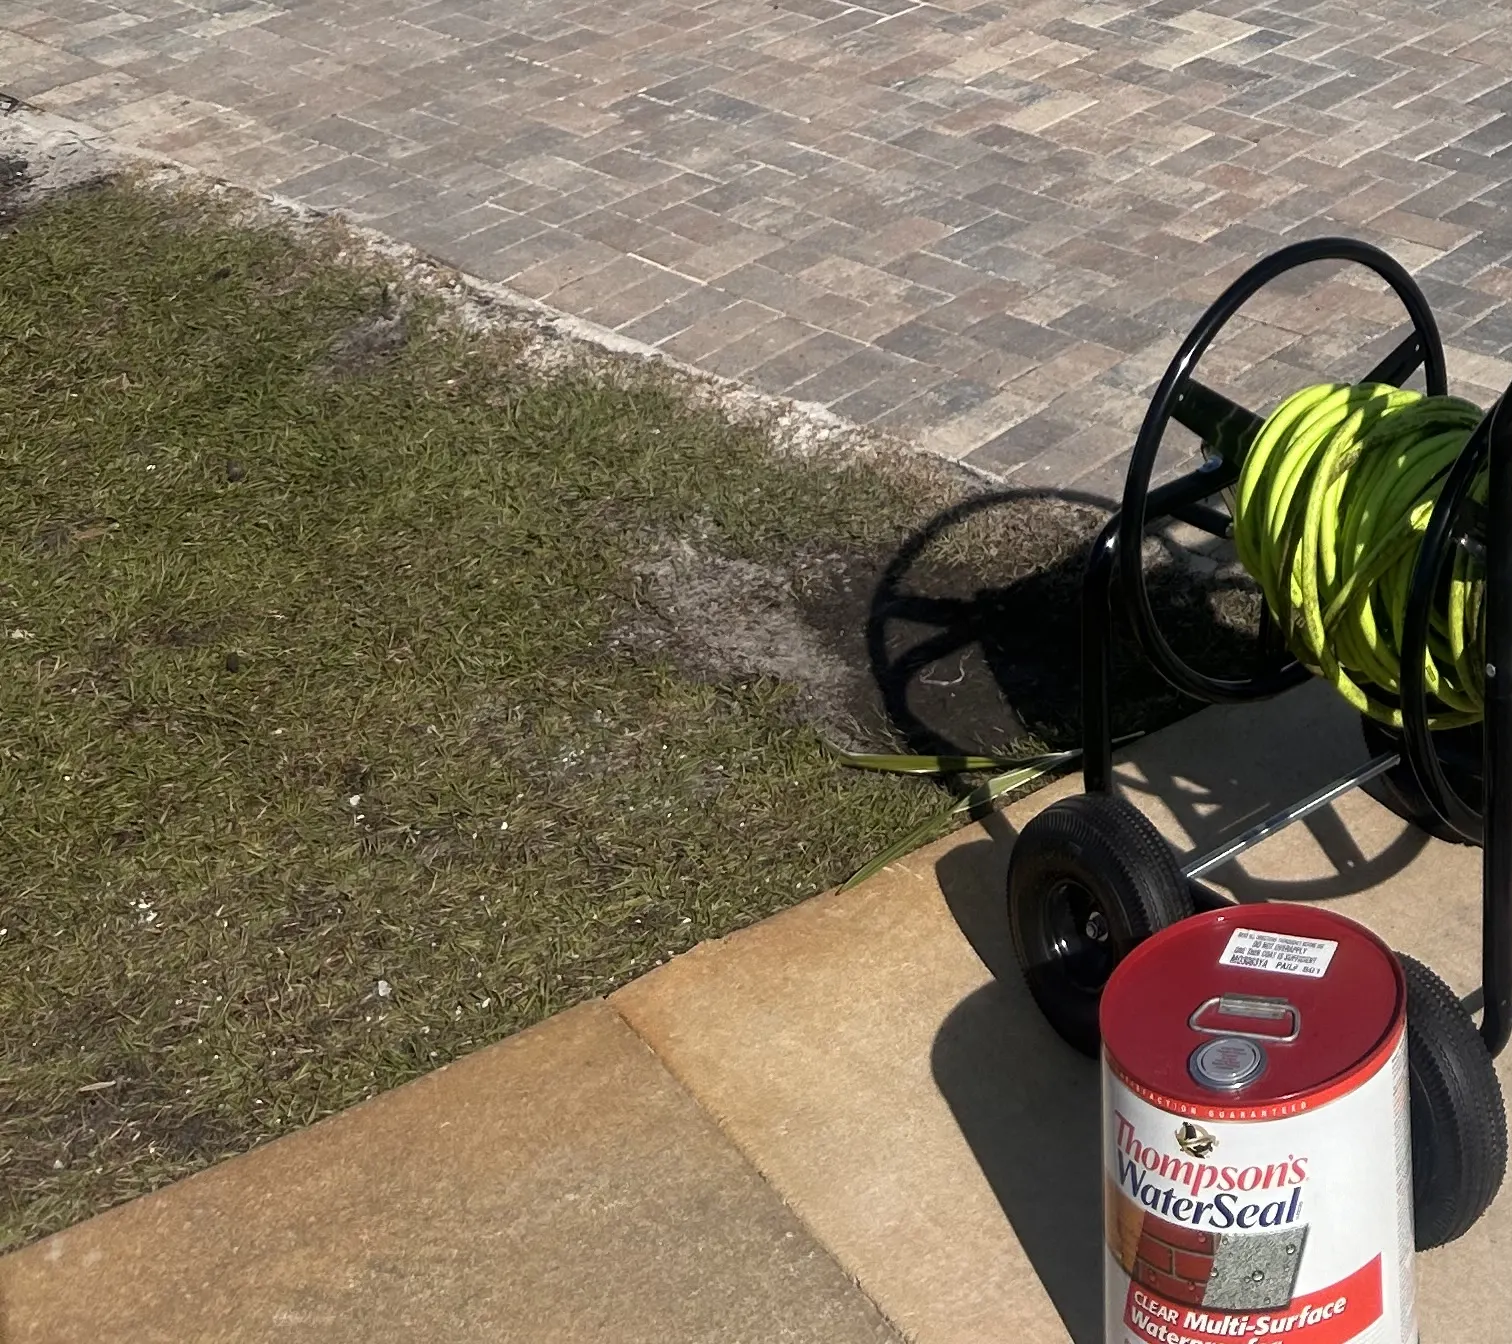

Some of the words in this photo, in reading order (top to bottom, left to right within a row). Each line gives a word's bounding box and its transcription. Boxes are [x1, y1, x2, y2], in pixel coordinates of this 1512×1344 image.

[1209, 1101, 1308, 1119] GUARANTEED
[1114, 1109, 1309, 1197] Thompson's
[1116, 1148, 1302, 1229] WaterSeal
[1134, 1290, 1179, 1325] CLEAR
[1183, 1296, 1348, 1336] Multi-Surface
